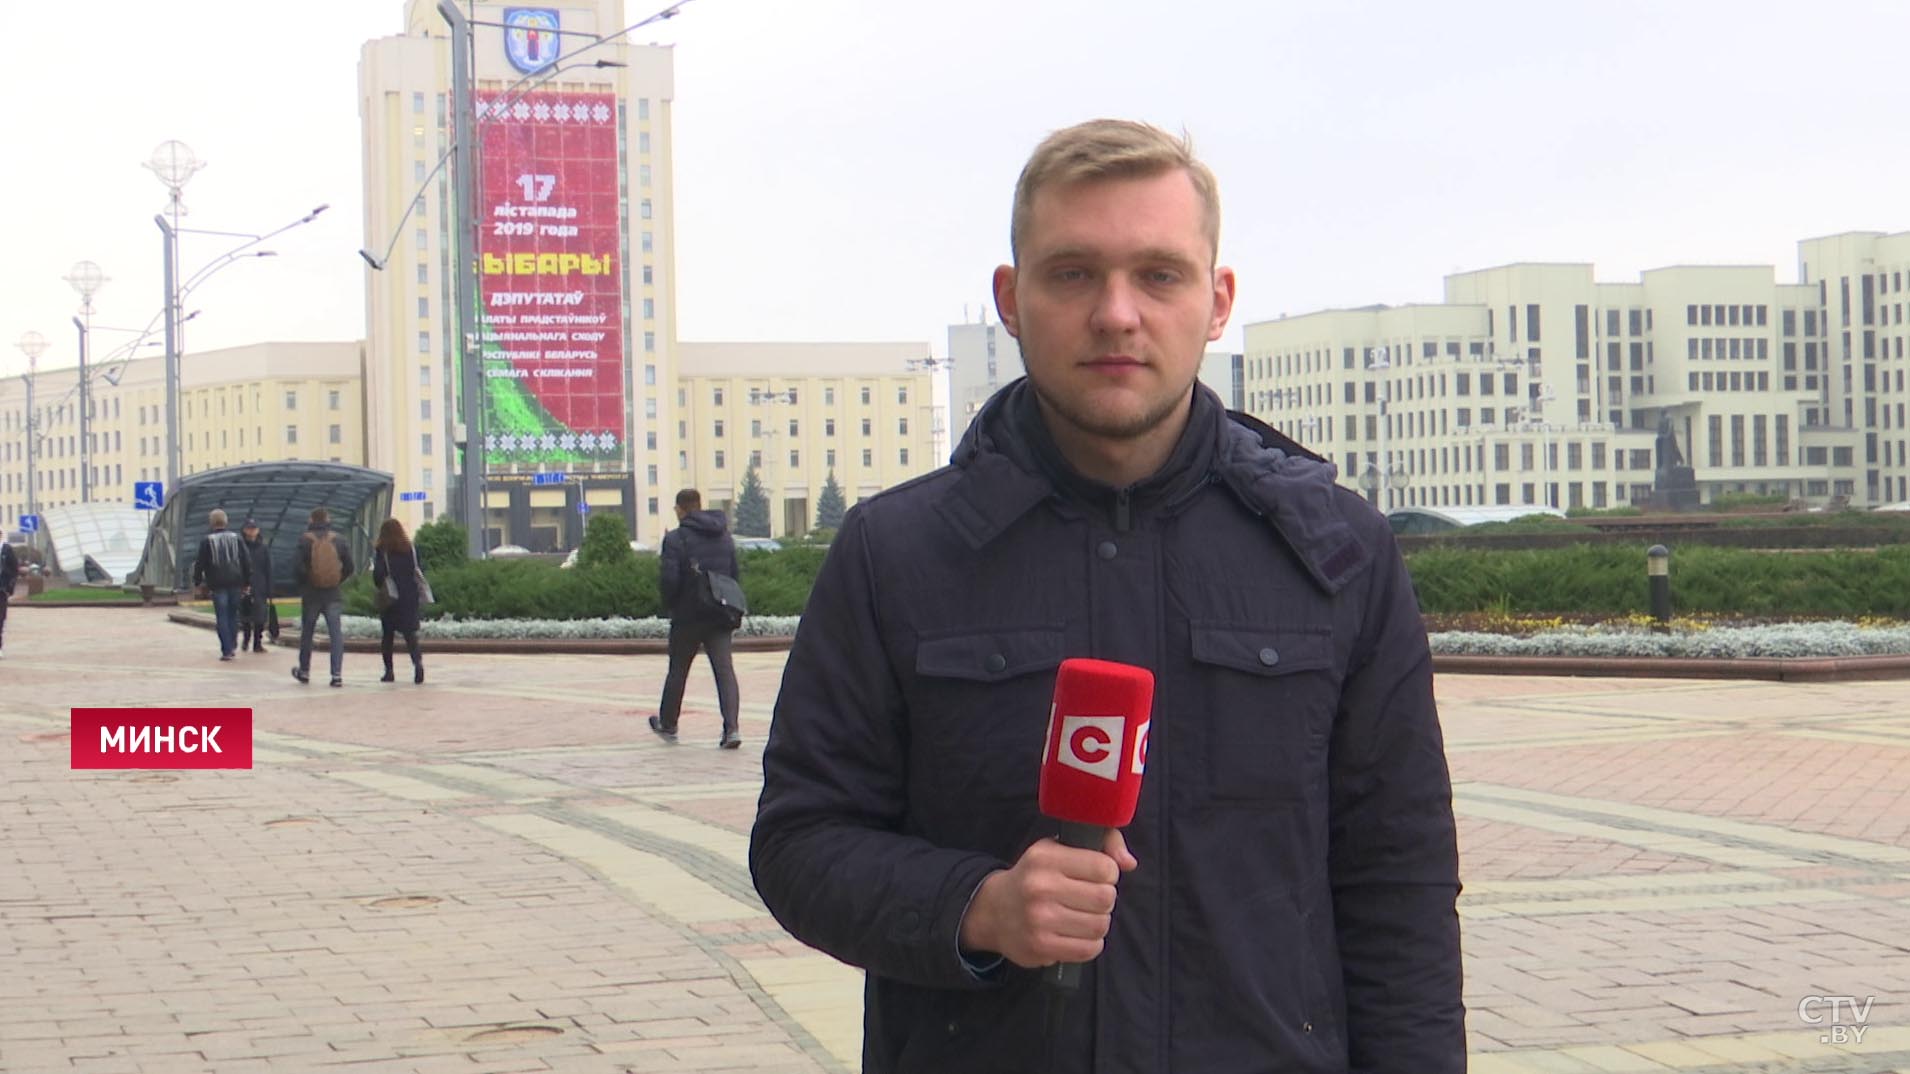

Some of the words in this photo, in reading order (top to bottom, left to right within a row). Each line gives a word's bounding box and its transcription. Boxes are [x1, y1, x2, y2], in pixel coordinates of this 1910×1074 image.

[516, 174, 556, 202] 17
[493, 222, 534, 236] 2019
[539, 225, 578, 237] года
[473, 253, 610, 275] ЫБАРЫ
